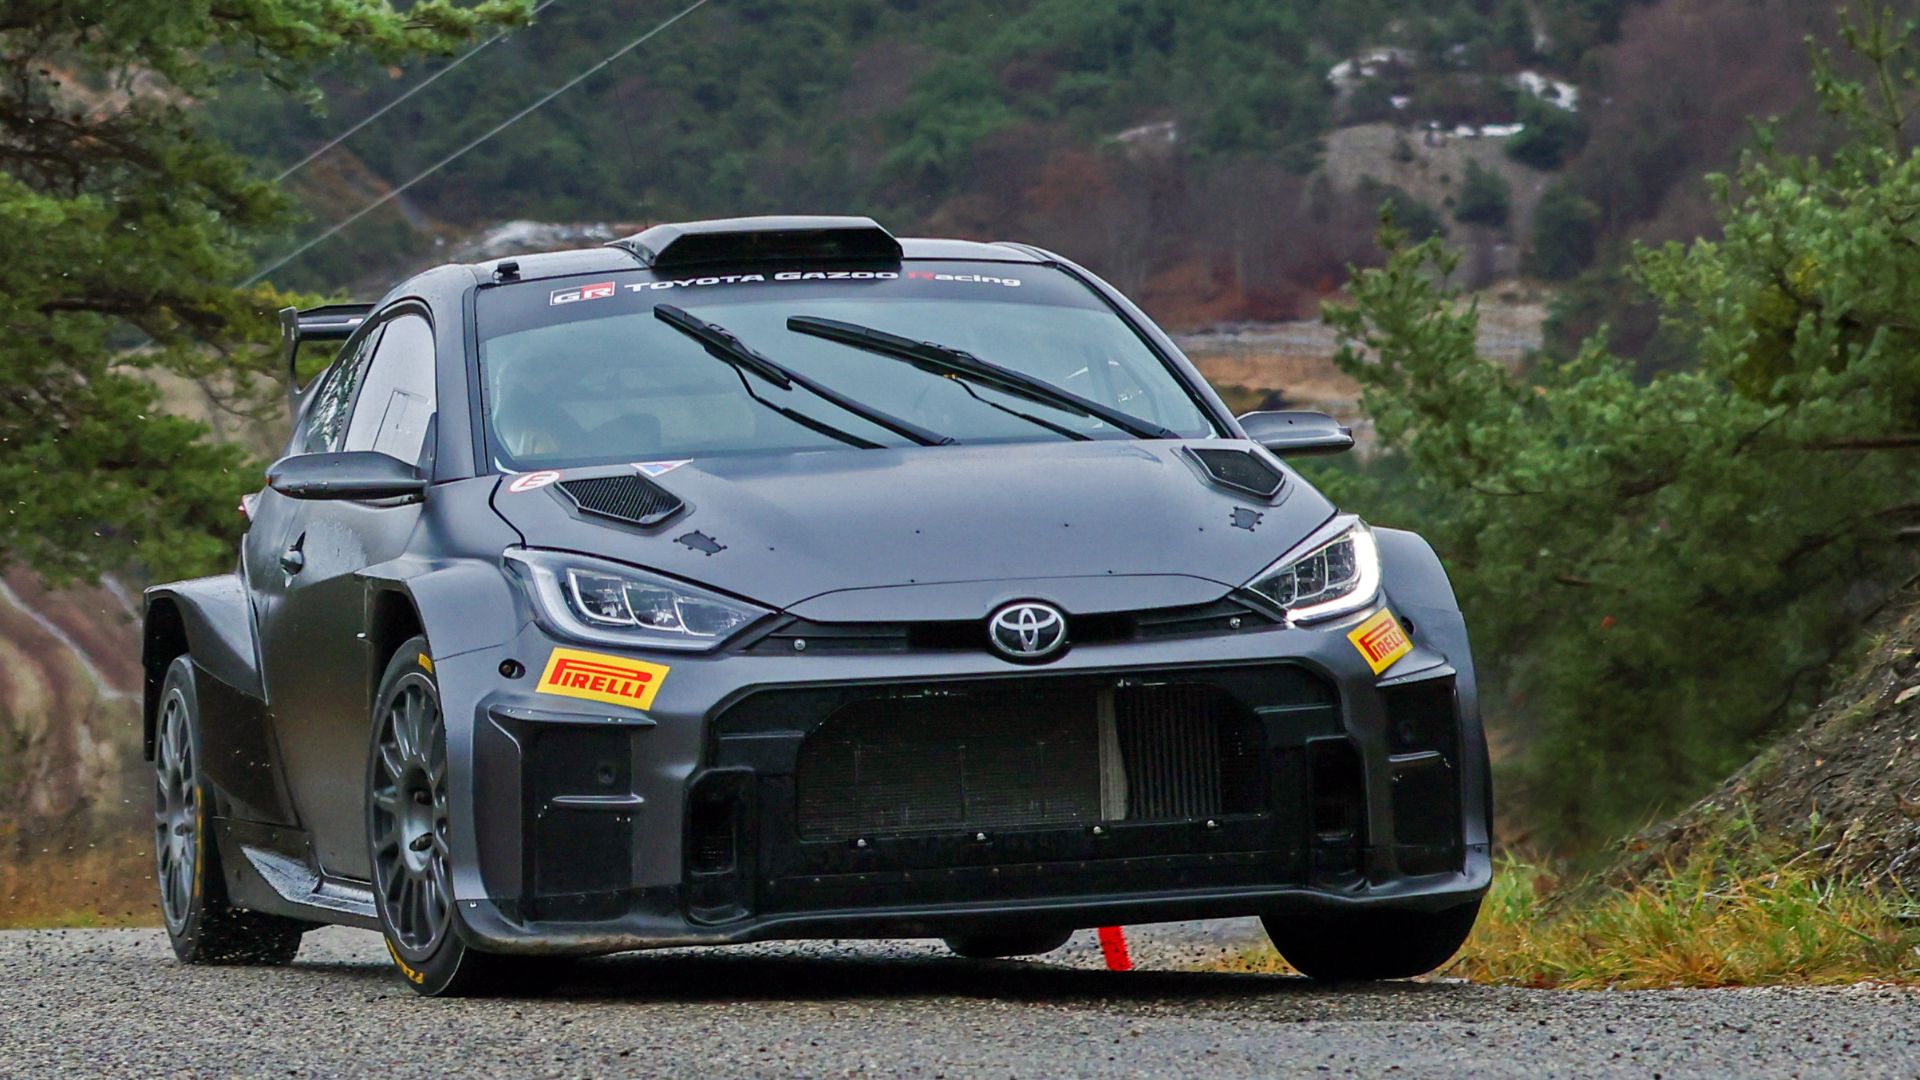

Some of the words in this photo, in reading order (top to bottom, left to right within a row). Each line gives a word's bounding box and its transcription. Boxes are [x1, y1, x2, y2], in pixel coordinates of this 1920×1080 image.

[552, 284, 613, 305] GR
[624, 274, 765, 292] TOYOTA
[774, 271, 899, 281] GAZOO
[907, 271, 1021, 287] Racing
[1358, 618, 1405, 663] PIRELLI
[548, 658, 653, 698] PIRELLI
